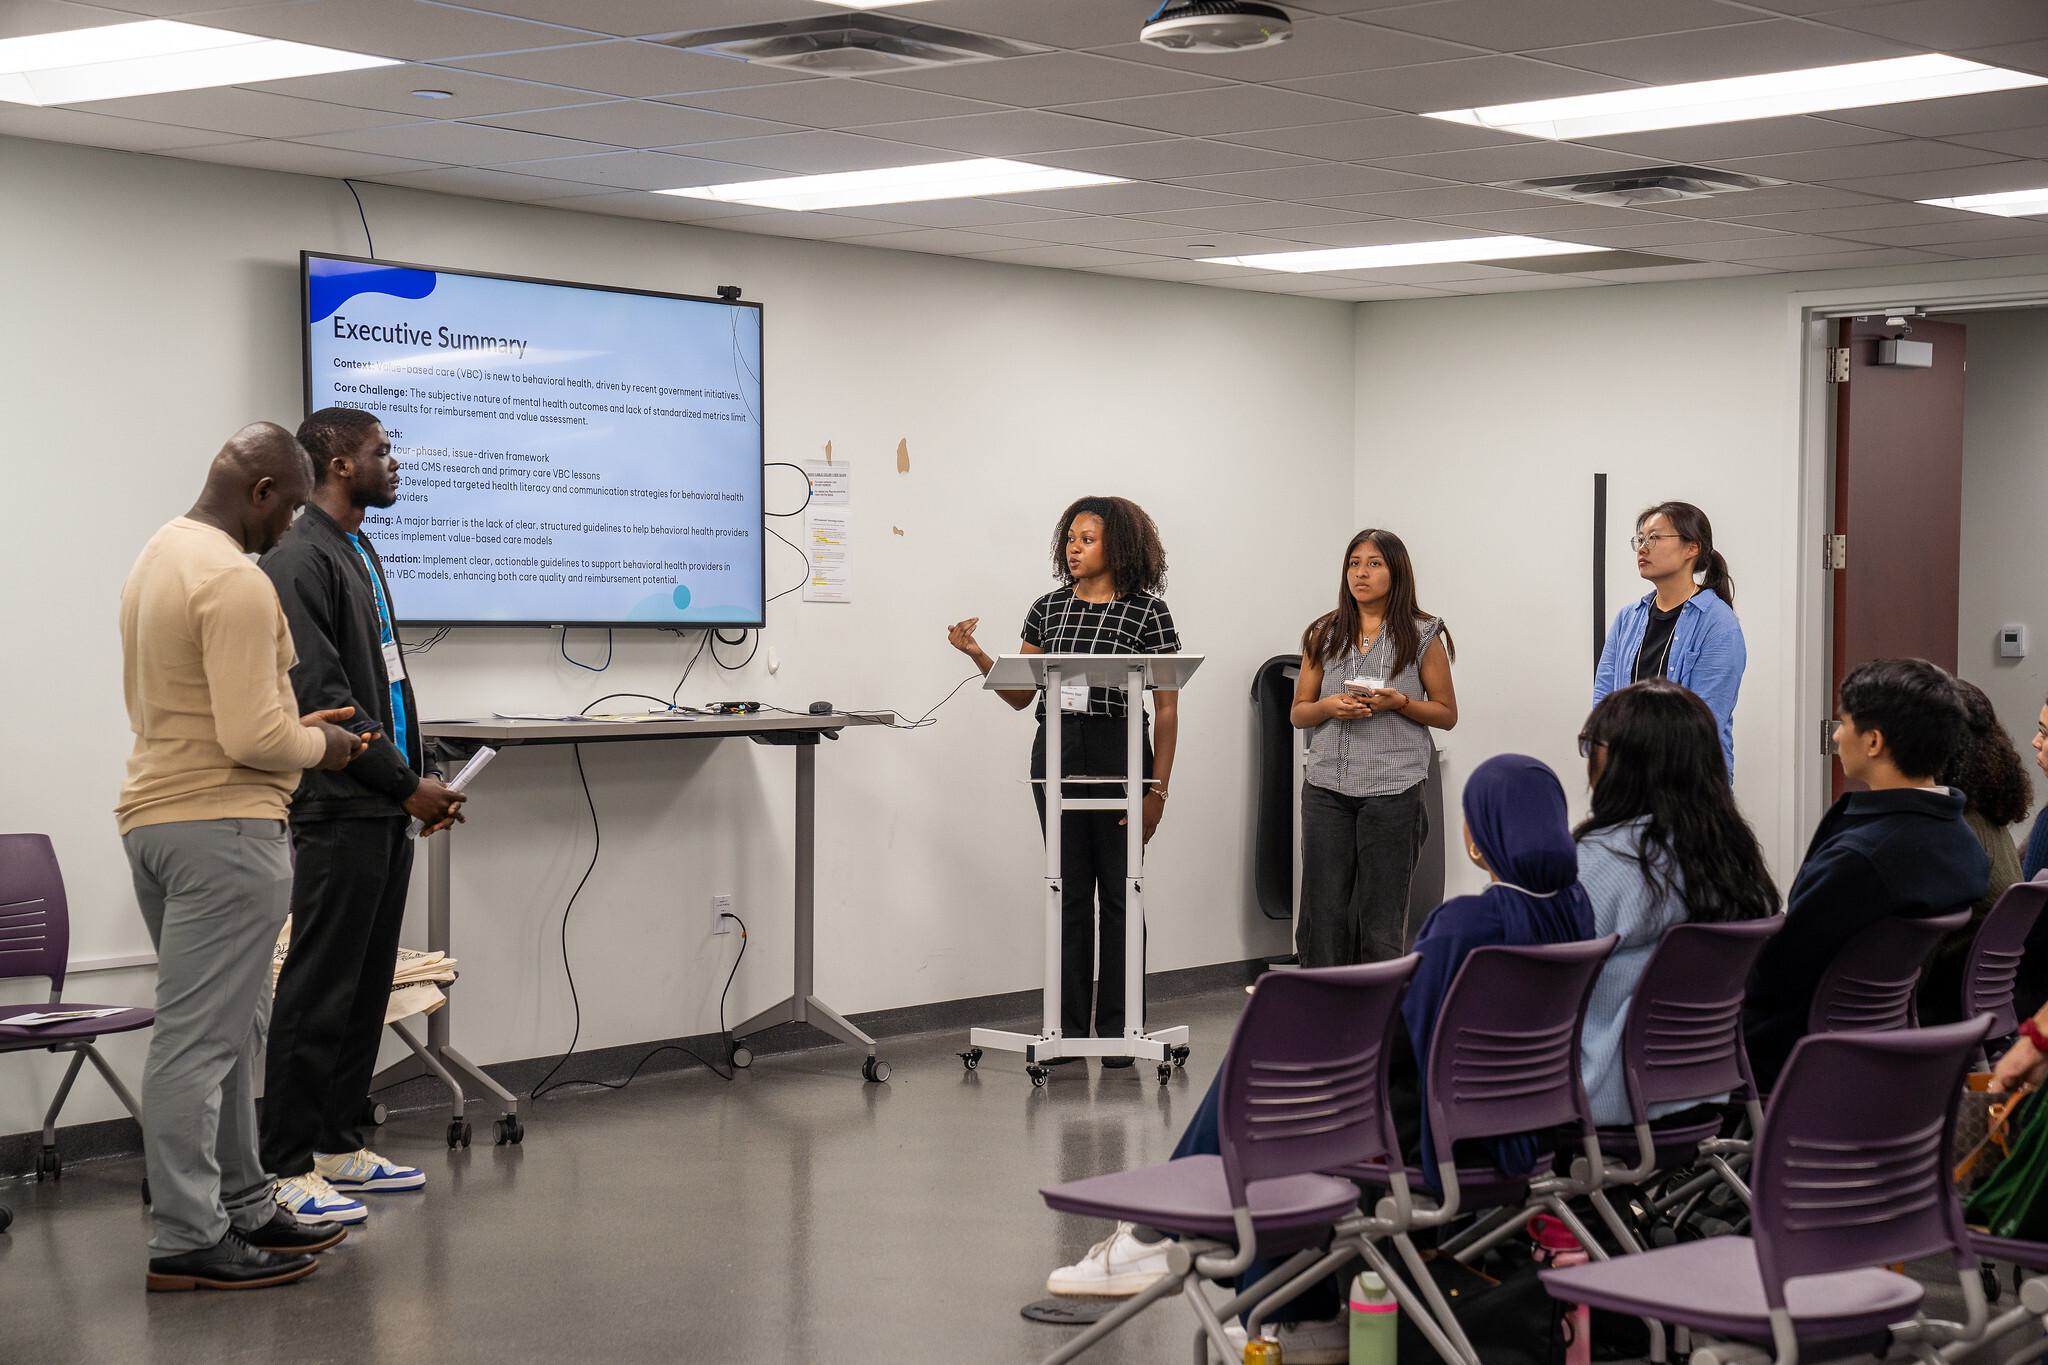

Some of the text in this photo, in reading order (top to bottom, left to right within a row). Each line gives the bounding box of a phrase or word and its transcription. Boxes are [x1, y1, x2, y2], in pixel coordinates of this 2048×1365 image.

[333, 315, 528, 360] Executive Summary
[333, 357, 375, 370] Context:
[435, 368, 456, 378] care
[456, 367, 483, 382] (VBC)
[484, 370, 492, 381] is
[492, 373, 511, 382] new
[511, 373, 522, 383] to
[522, 372, 566, 387] behavioral
[566, 377, 595, 390] health,
[595, 379, 620, 391] driven
[621, 381, 632, 394] by
[632, 384, 658, 394] recent
[658, 386, 703, 398] government
[703, 388, 741, 401] initiatives.
[333, 381, 747, 423] Core Challenge: The subjective nature of mental health outcomes and lack of standardized metrics limit
[334, 400, 589, 426] measurable results for reimbursement and value assessment.
[392, 443, 550, 463] four-phased, issue-driven framework
[420, 461, 442, 473] CMS
[442, 464, 481, 474] research
[481, 465, 498, 475] and
[499, 466, 532, 479] primary
[532, 469, 552, 478] care
[552, 468, 571, 479] VBC
[571, 469, 601, 481] lessons
[404, 475, 452, 490] Developed
[452, 479, 491, 492] targeted
[491, 480, 518, 492] health
[519, 481, 552, 495] literacy
[551, 483, 568, 494] and
[568, 485, 629, 497] communication
[629, 488, 669, 500] strategies
[669, 488, 681, 499] for
[681, 489, 721, 501] behavioral
[721, 491, 745, 502] health
[395, 515, 403, 525] A
[404, 515, 430, 528] major
[430, 516, 461, 527] barrier
[461, 517, 469, 528] is
[470, 517, 485, 528] the
[485, 518, 504, 529] lack
[504, 519, 514, 529] of
[515, 519, 539, 531] clear,
[539, 521, 582, 532] structured
[582, 522, 622, 535] guidelines
[621, 524, 632, 534] to
[632, 523, 650, 536] help
[650, 524, 690, 536] behavioral
[690, 526, 715, 536] health
[715, 527, 749, 539] providers
[400, 530, 447, 544] implement
[447, 532, 502, 544] value-based
[502, 536, 522, 545] care
[523, 535, 553, 546] models
[422, 554, 468, 568] Implement
[467, 555, 493, 567] clear,
[494, 556, 539, 567] actionable
[539, 557, 580, 569] guidelines
[580, 559, 590, 568] to
[591, 560, 622, 571] support
[622, 559, 663, 570] behavioral
[663, 560, 688, 571] health
[688, 561, 724, 573] providers
[723, 561, 731, 572] in
[396, 568, 416, 580] VBC
[417, 569, 452, 581] models,
[452, 570, 497, 583] enhancing
[497, 571, 518, 582] both
[518, 573, 538, 582] care
[538, 572, 567, 585] quality
[567, 572, 583, 583] and
[584, 573, 642, 584] reimbursement
[642, 574, 679, 586] potential.
